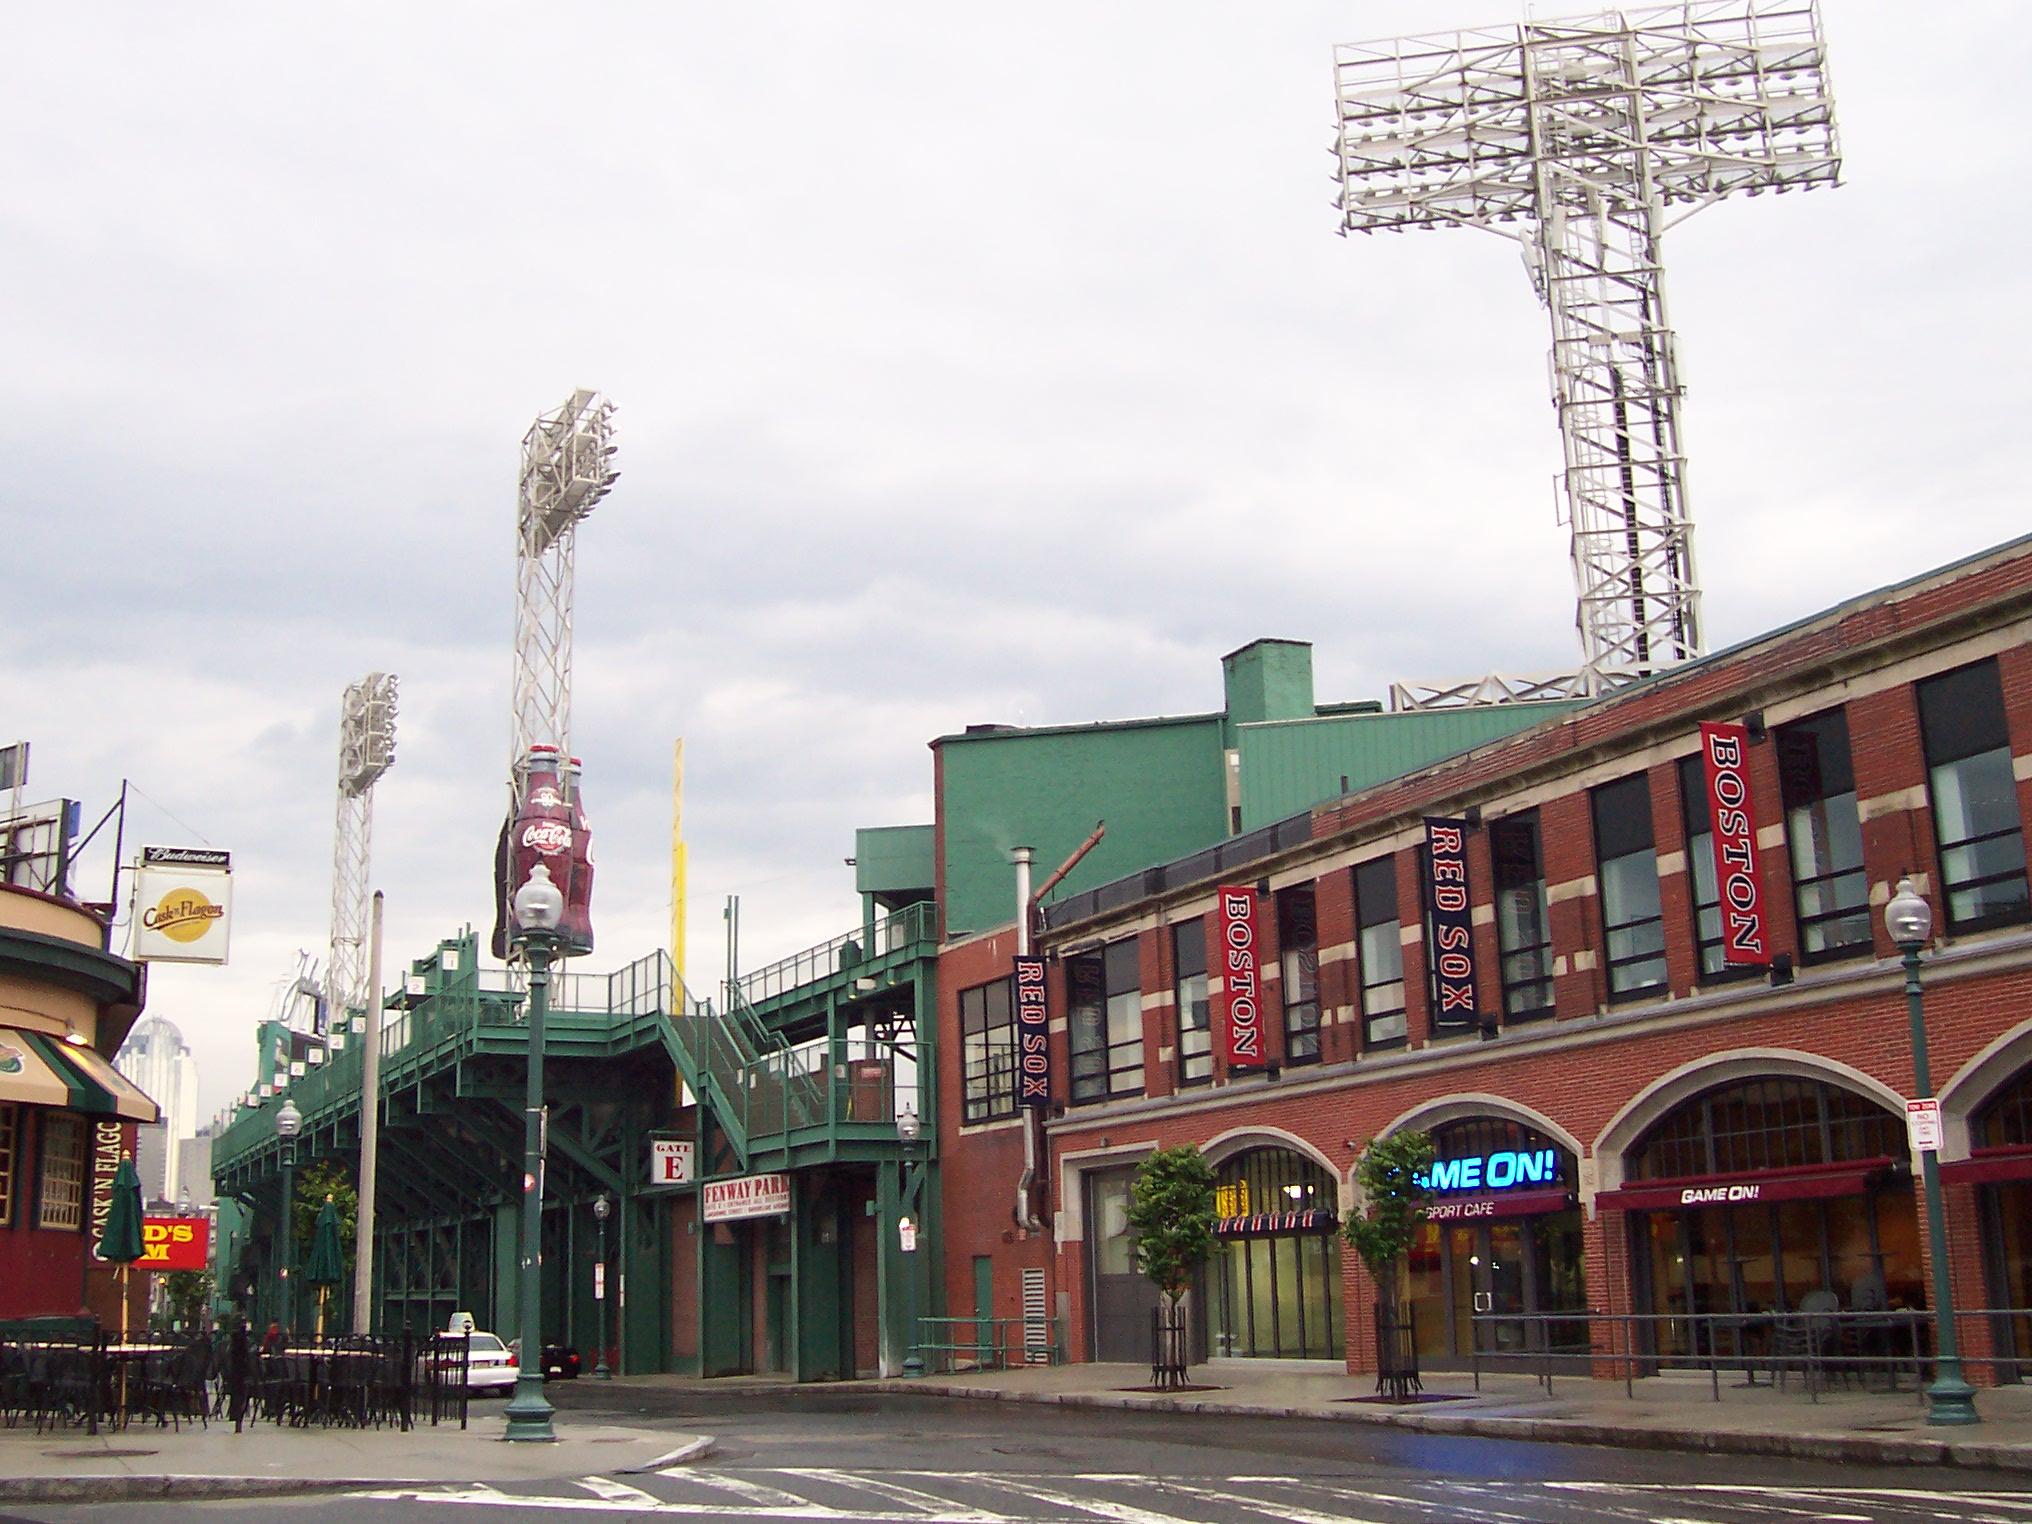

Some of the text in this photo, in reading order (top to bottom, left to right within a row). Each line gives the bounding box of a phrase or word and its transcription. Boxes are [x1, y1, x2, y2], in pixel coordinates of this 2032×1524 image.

[522, 825, 573, 848] Coca-Cola
[1708, 733, 1762, 954] BOSTON
[148, 847, 226, 863] Budweiser
[143, 904, 174, 928] Cask
[180, 900, 224, 919] Flagon
[1430, 826, 1474, 1013] RED SOX
[1225, 894, 1257, 1058] BOSTON
[1017, 960, 1048, 1098] RED SOX
[656, 1143, 691, 1153] GATE
[665, 1156, 684, 1180] E
[1486, 1149, 1554, 1188] ON!
[705, 1180, 752, 1203] FENWAY
[755, 1175, 791, 1197] PARK
[1681, 1185, 1759, 1204] GAME ON!
[1464, 1201, 1495, 1216] CAFE
